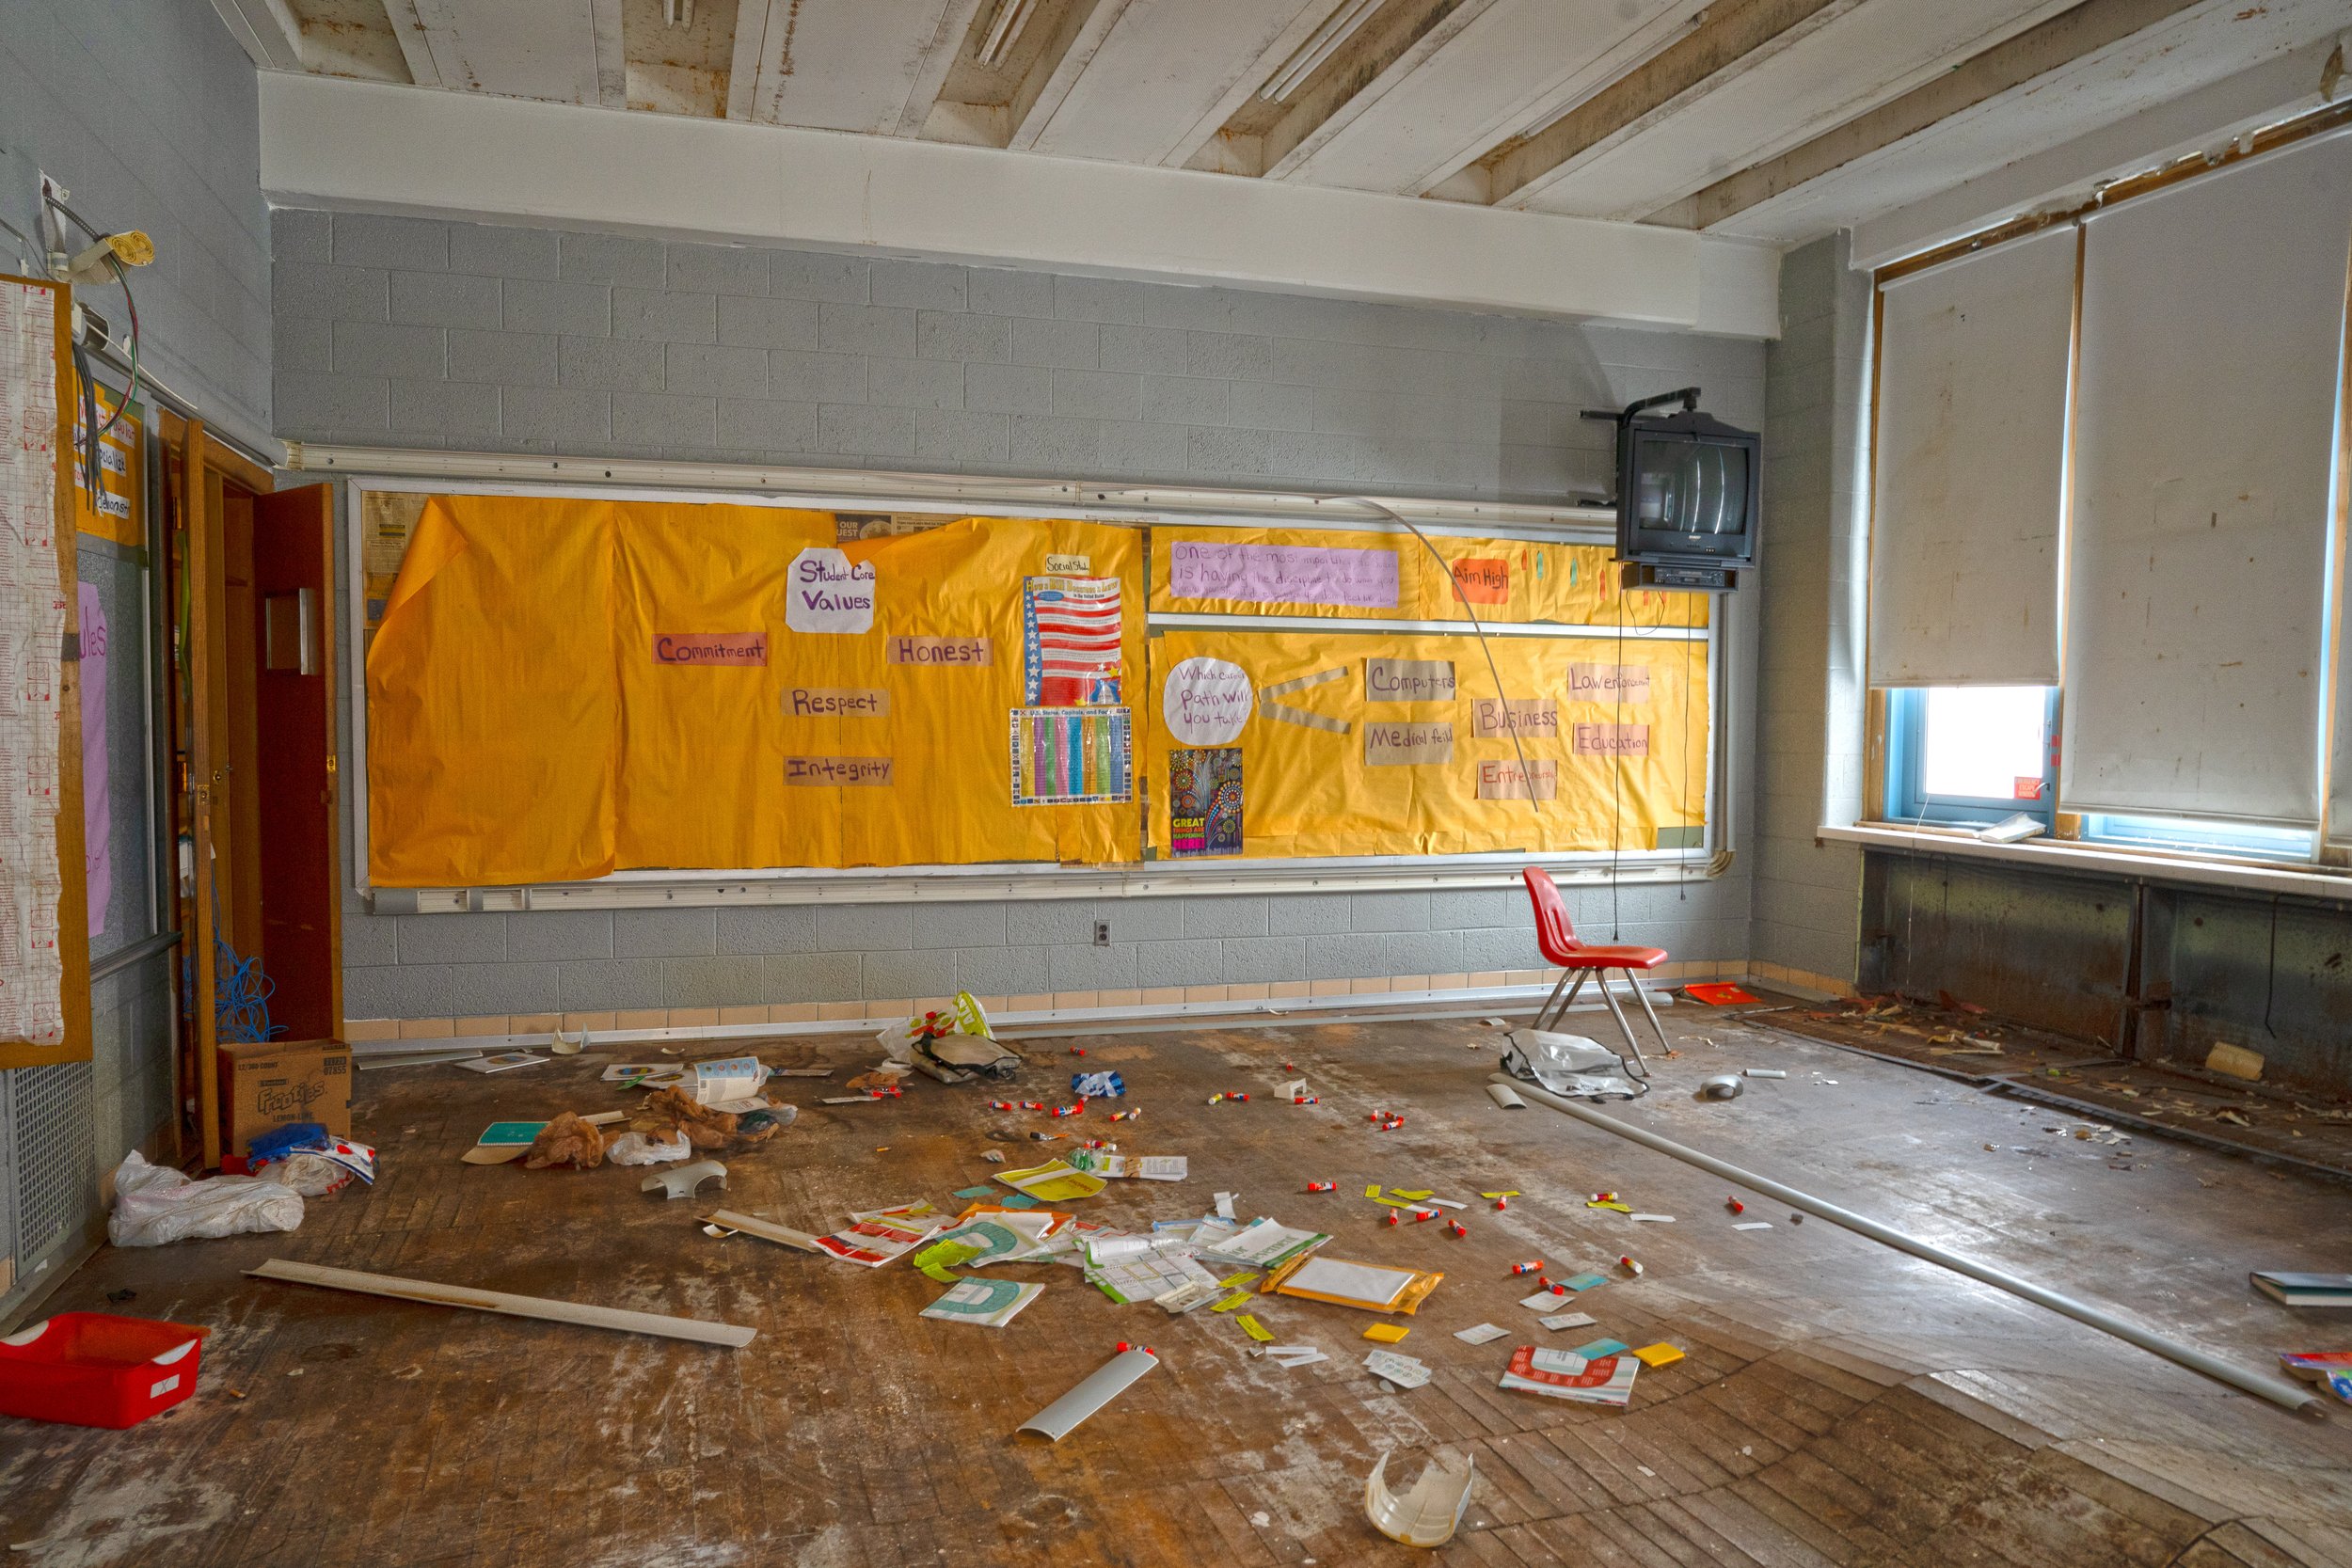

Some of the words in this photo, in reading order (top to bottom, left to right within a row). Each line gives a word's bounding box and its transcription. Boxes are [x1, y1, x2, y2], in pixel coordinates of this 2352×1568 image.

[800, 560, 849, 583] Student
[850, 564, 876, 581] Core
[1046, 556, 1073, 572] Social
[1454, 565, 1481, 585] Aim
[1484, 565, 1508, 590] High
[802, 590, 871, 611] Values
[658, 638, 765, 662] Commitment
[898, 638, 984, 662] Honest
[1179, 666, 1216, 681] Which
[1372, 666, 1455, 694] Computers
[791, 689, 878, 716] Respect
[1184, 713, 1211, 734] you
[1479, 703, 1558, 731] Business
[1370, 728, 1427, 750] Medical
[1578, 724, 1648, 751] Education
[787, 758, 890, 782] Integrity
[1172, 817, 1205, 828] GREAT
